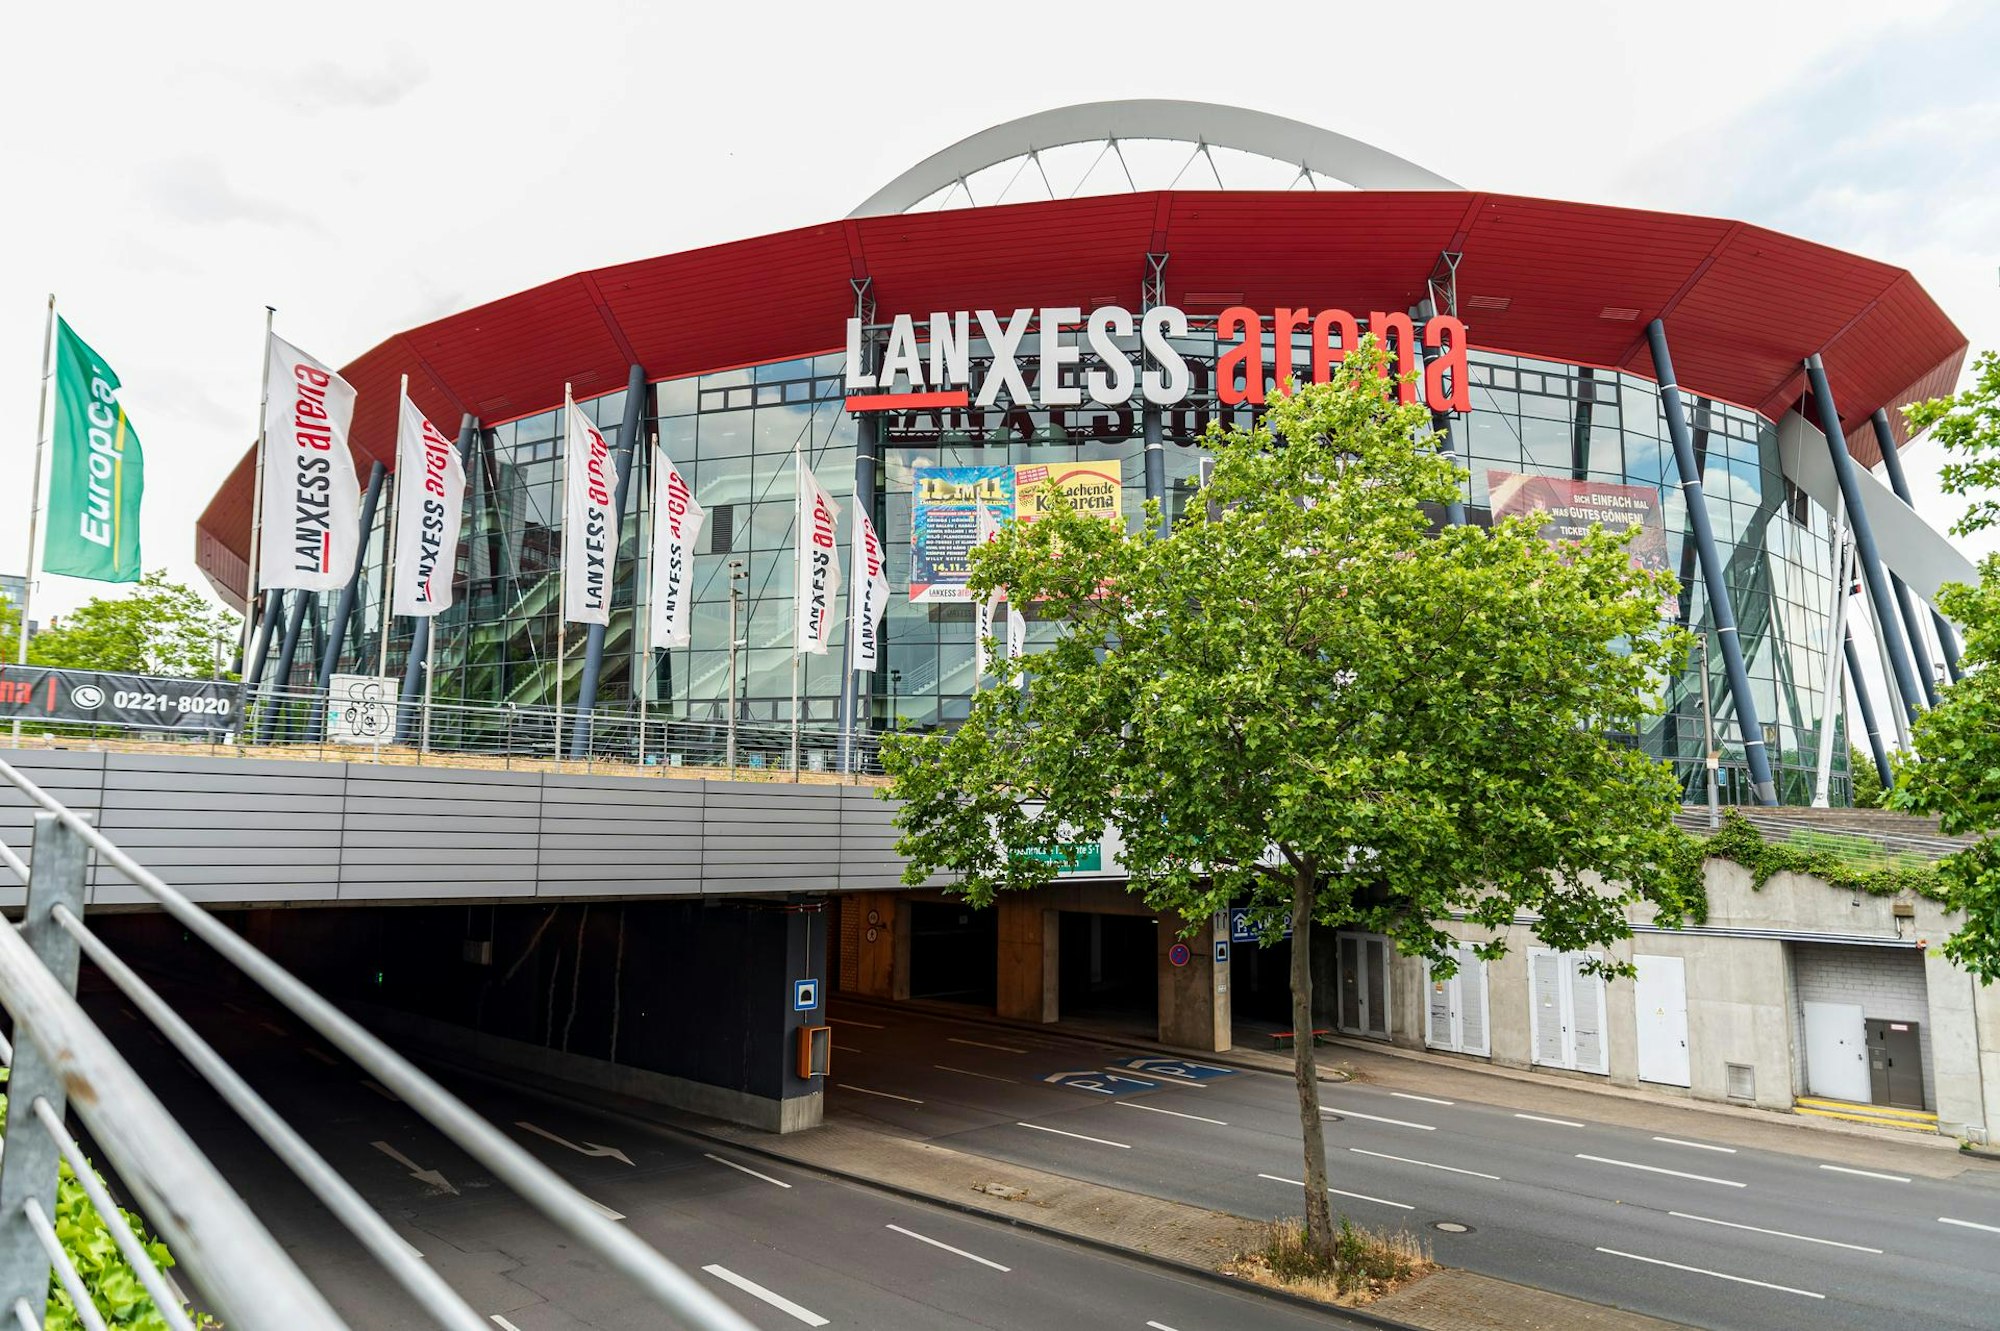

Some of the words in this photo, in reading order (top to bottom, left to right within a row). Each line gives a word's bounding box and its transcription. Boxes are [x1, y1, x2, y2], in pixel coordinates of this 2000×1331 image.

[845, 305, 1190, 406] LANXESS
[1216, 306, 1473, 413] arena
[293, 363, 332, 451] arena
[79, 364, 123, 548] Europcar
[1064, 481, 1115, 497] achende
[295, 455, 331, 573] LANXESS
[812, 492, 834, 549] are
[1036, 494, 1115, 512] Karena
[1552, 507, 1570, 517] WAS
[1569, 506, 1600, 521] GUTES
[1573, 494, 1591, 505] SICH
[1591, 493, 1632, 508] EINFACH
[585, 507, 605, 610] LANXESS
[666, 543, 682, 634] ANXESS
[928, 588, 956, 598] LANXESS
[957, 588, 975, 598] aren
[862, 579, 875, 660] LANXE
[113, 690, 230, 716] 0221-8020
